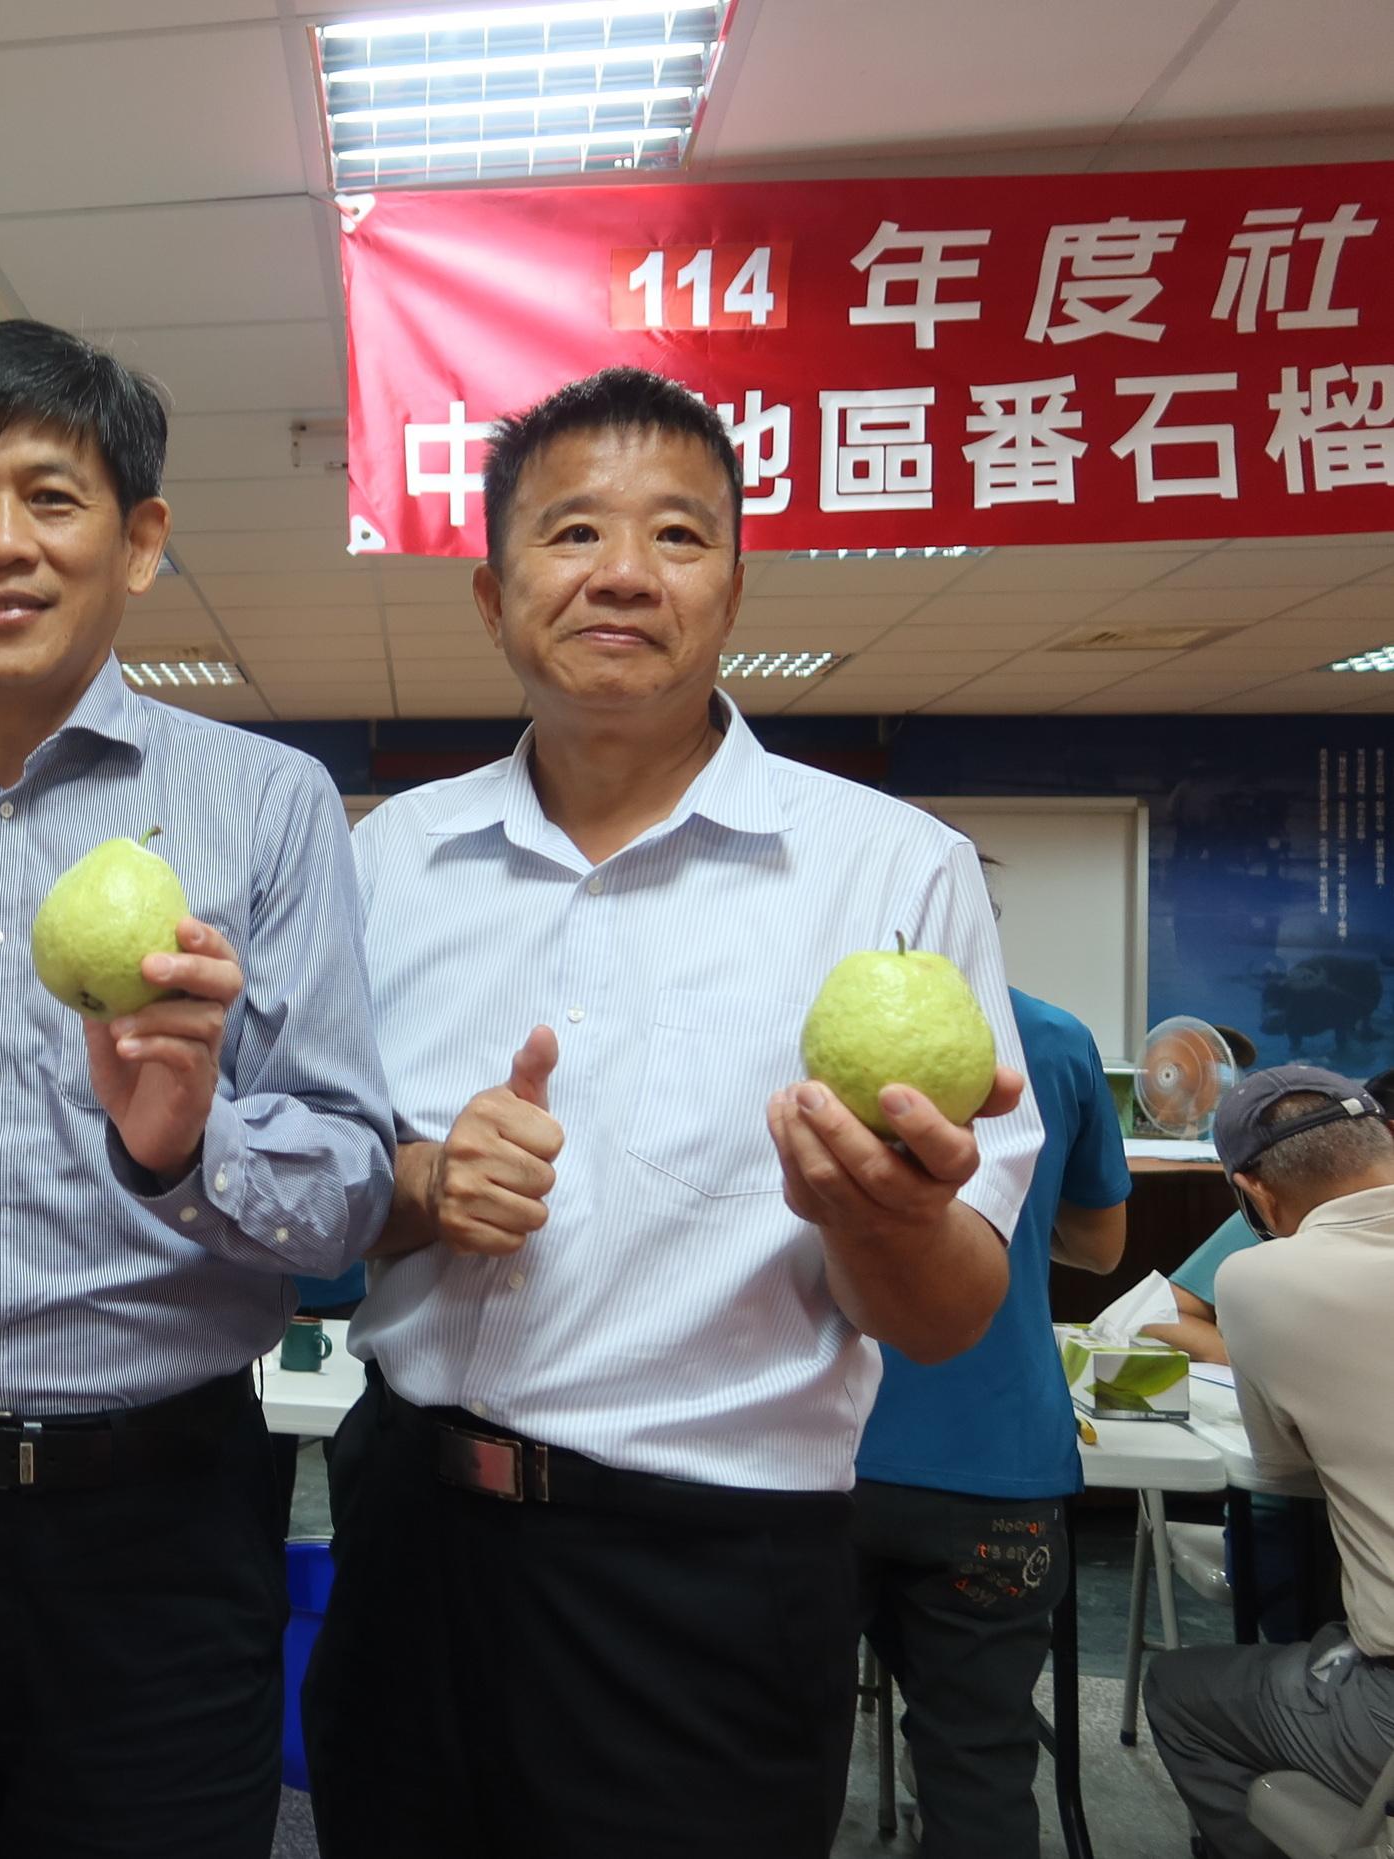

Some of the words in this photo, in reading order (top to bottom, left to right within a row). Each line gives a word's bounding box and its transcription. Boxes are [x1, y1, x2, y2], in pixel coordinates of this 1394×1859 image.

[629, 246, 776, 328] 114
[848, 204, 1377, 350] 年度社
[405, 363, 1394, 527] 中地區番石榴
